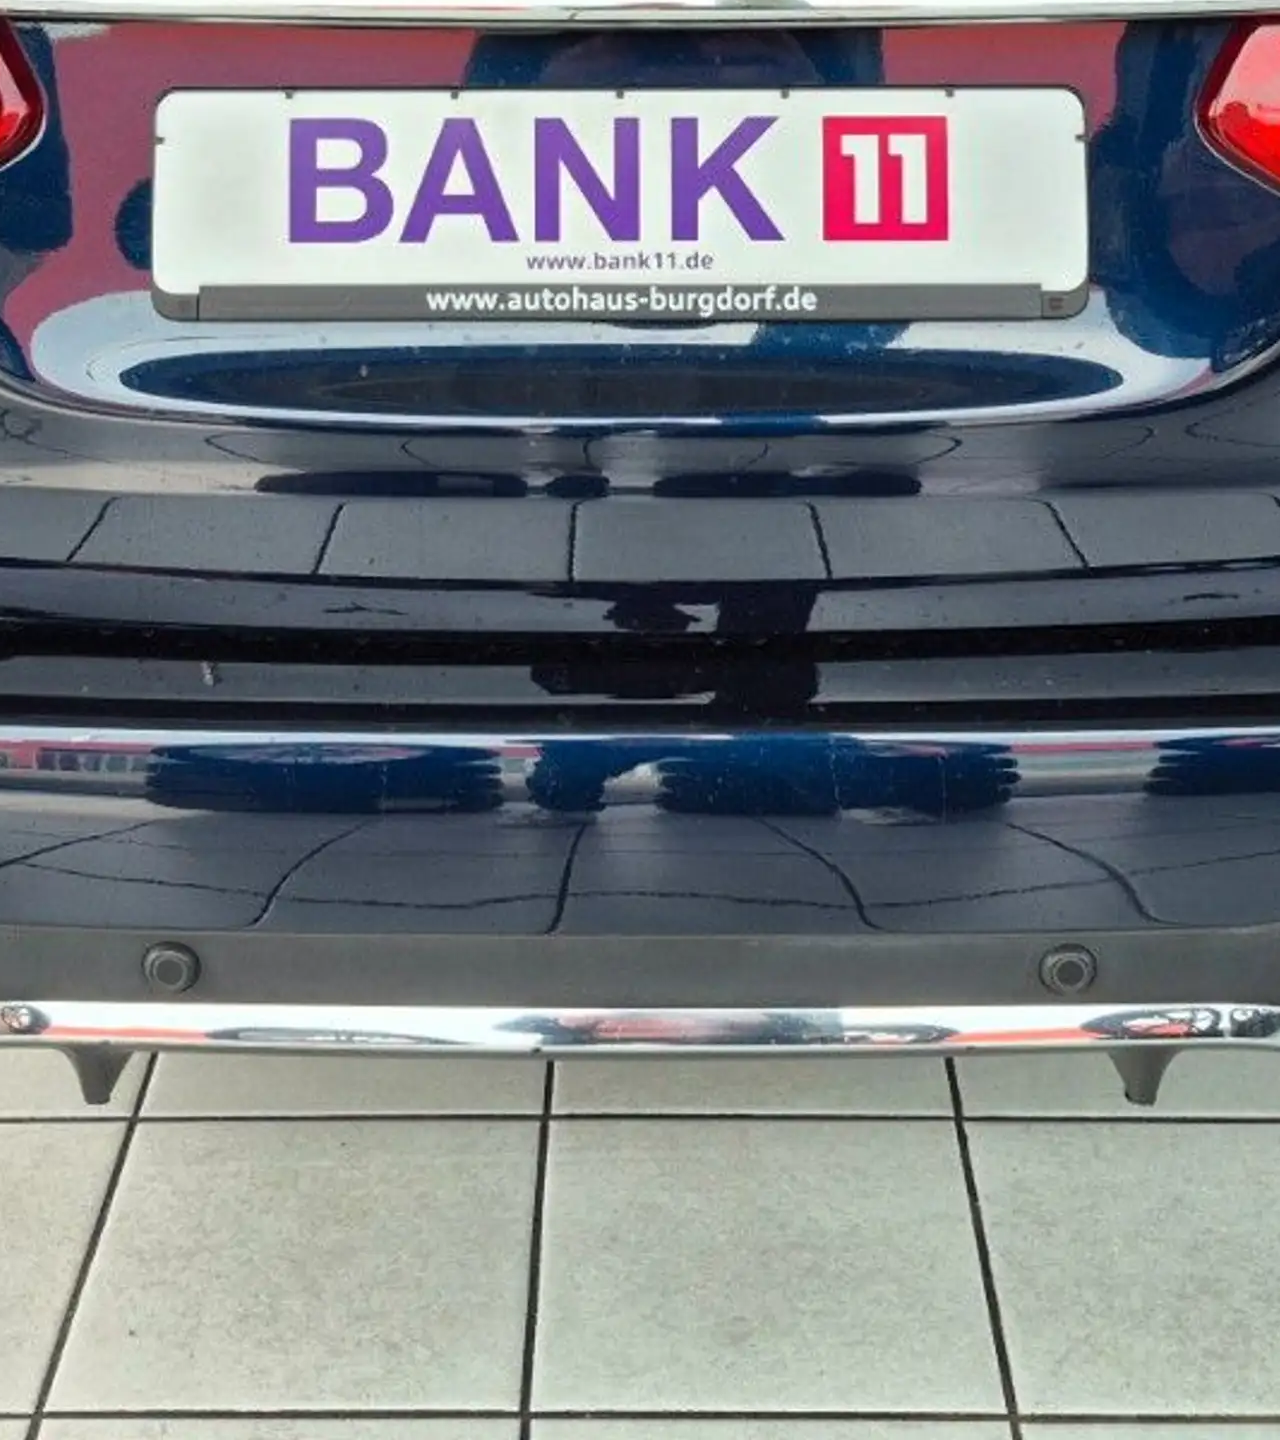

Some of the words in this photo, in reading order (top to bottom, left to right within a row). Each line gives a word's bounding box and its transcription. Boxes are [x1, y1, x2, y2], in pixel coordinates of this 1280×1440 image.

[287, 116, 785, 243] BANK
[836, 131, 929, 227] 11
[526, 250, 715, 271] www.bank11.de
[425, 285, 818, 318] www.autohaus-burgdorf.de
